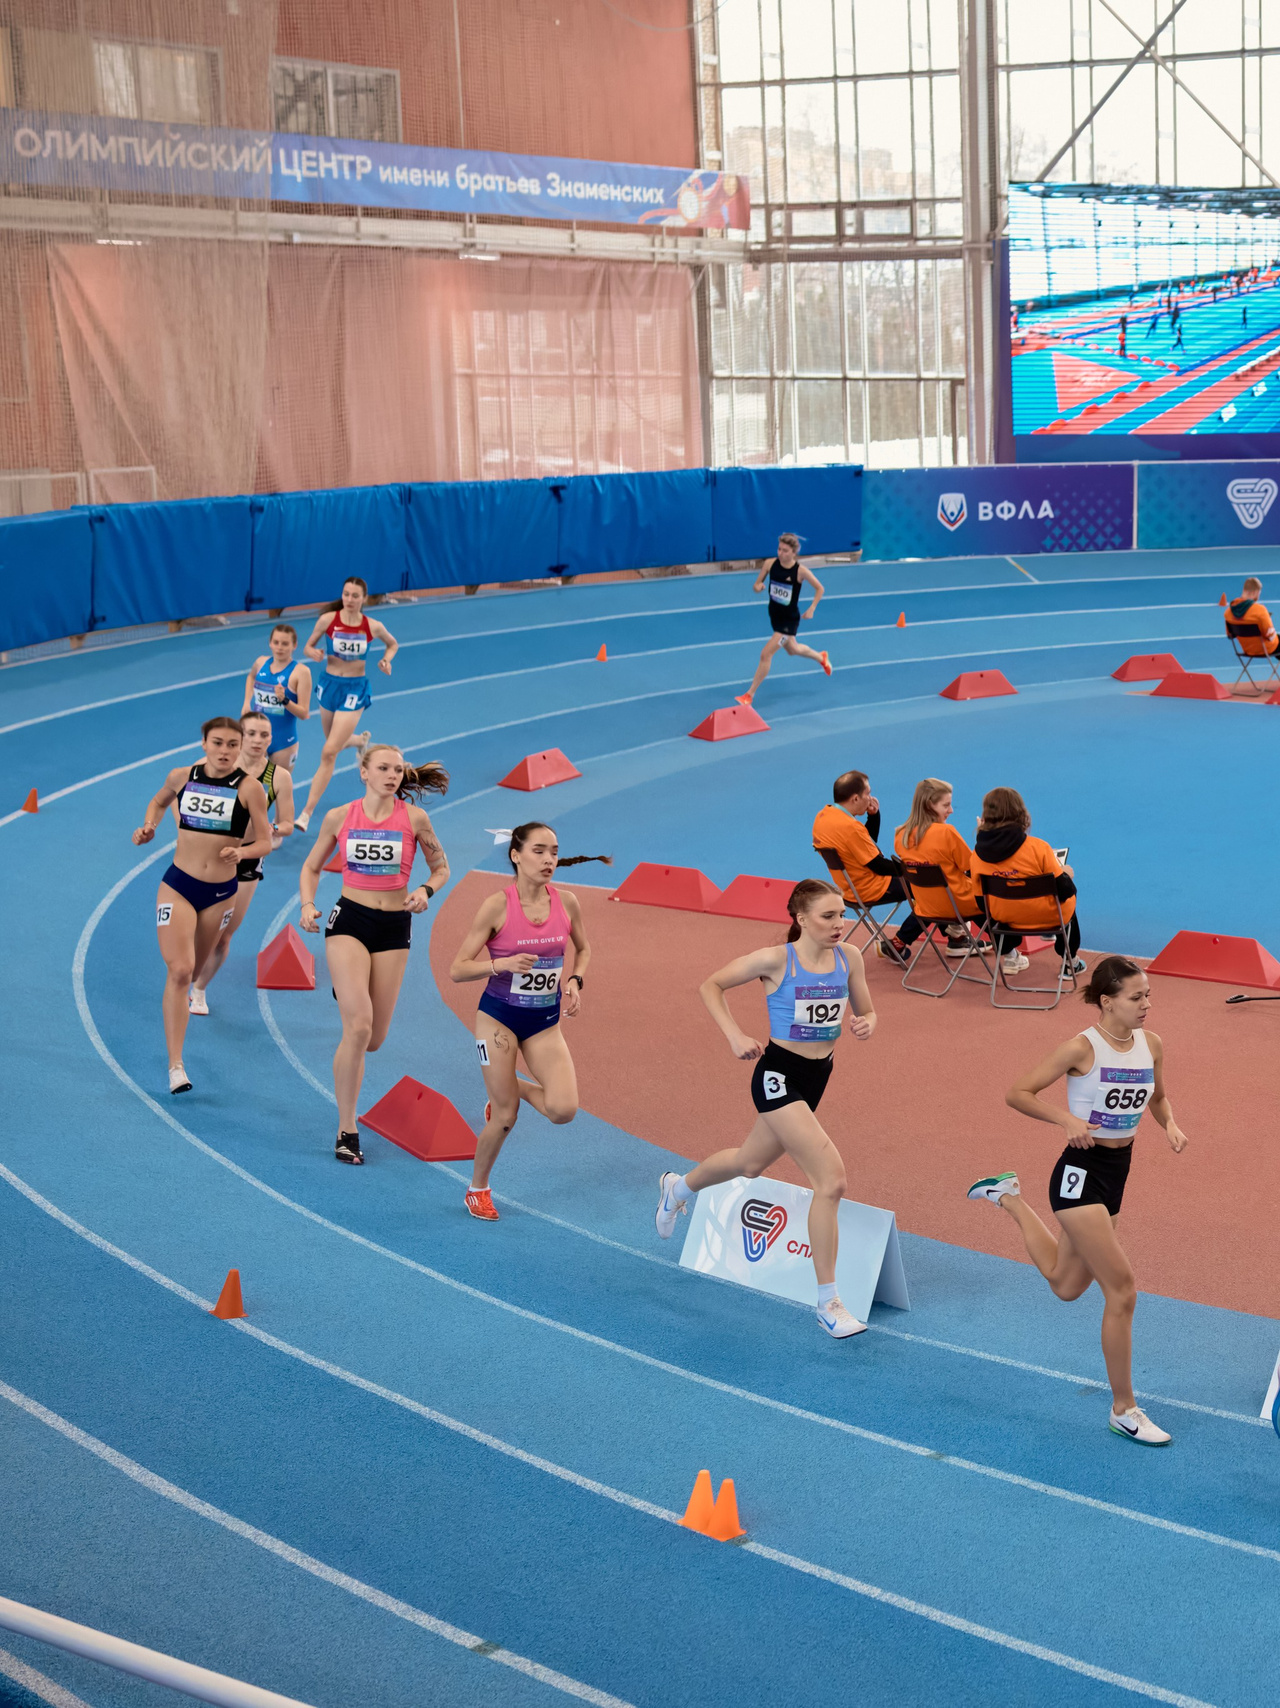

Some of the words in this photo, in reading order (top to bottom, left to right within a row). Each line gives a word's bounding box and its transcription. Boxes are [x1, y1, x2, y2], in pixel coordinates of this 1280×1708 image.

[14, 127, 273, 175] ОЛИМПИЙСКИЙ
[279, 148, 372, 182] ЦЕНТР
[378, 165, 450, 188] имени
[456, 164, 542, 198] братьев
[547, 172, 665, 204] Знаменских
[978, 500, 1055, 521] ВФЛА
[339, 641, 360, 653] 341
[187, 796, 225, 817] 354
[354, 843, 394, 861] 553
[157, 907, 171, 922] 15
[520, 972, 557, 991] 296
[806, 1003, 841, 1024] 192
[768, 1076, 780, 1093] 3
[1104, 1088, 1148, 1110] 658
[1067, 1172, 1080, 1193] 9
